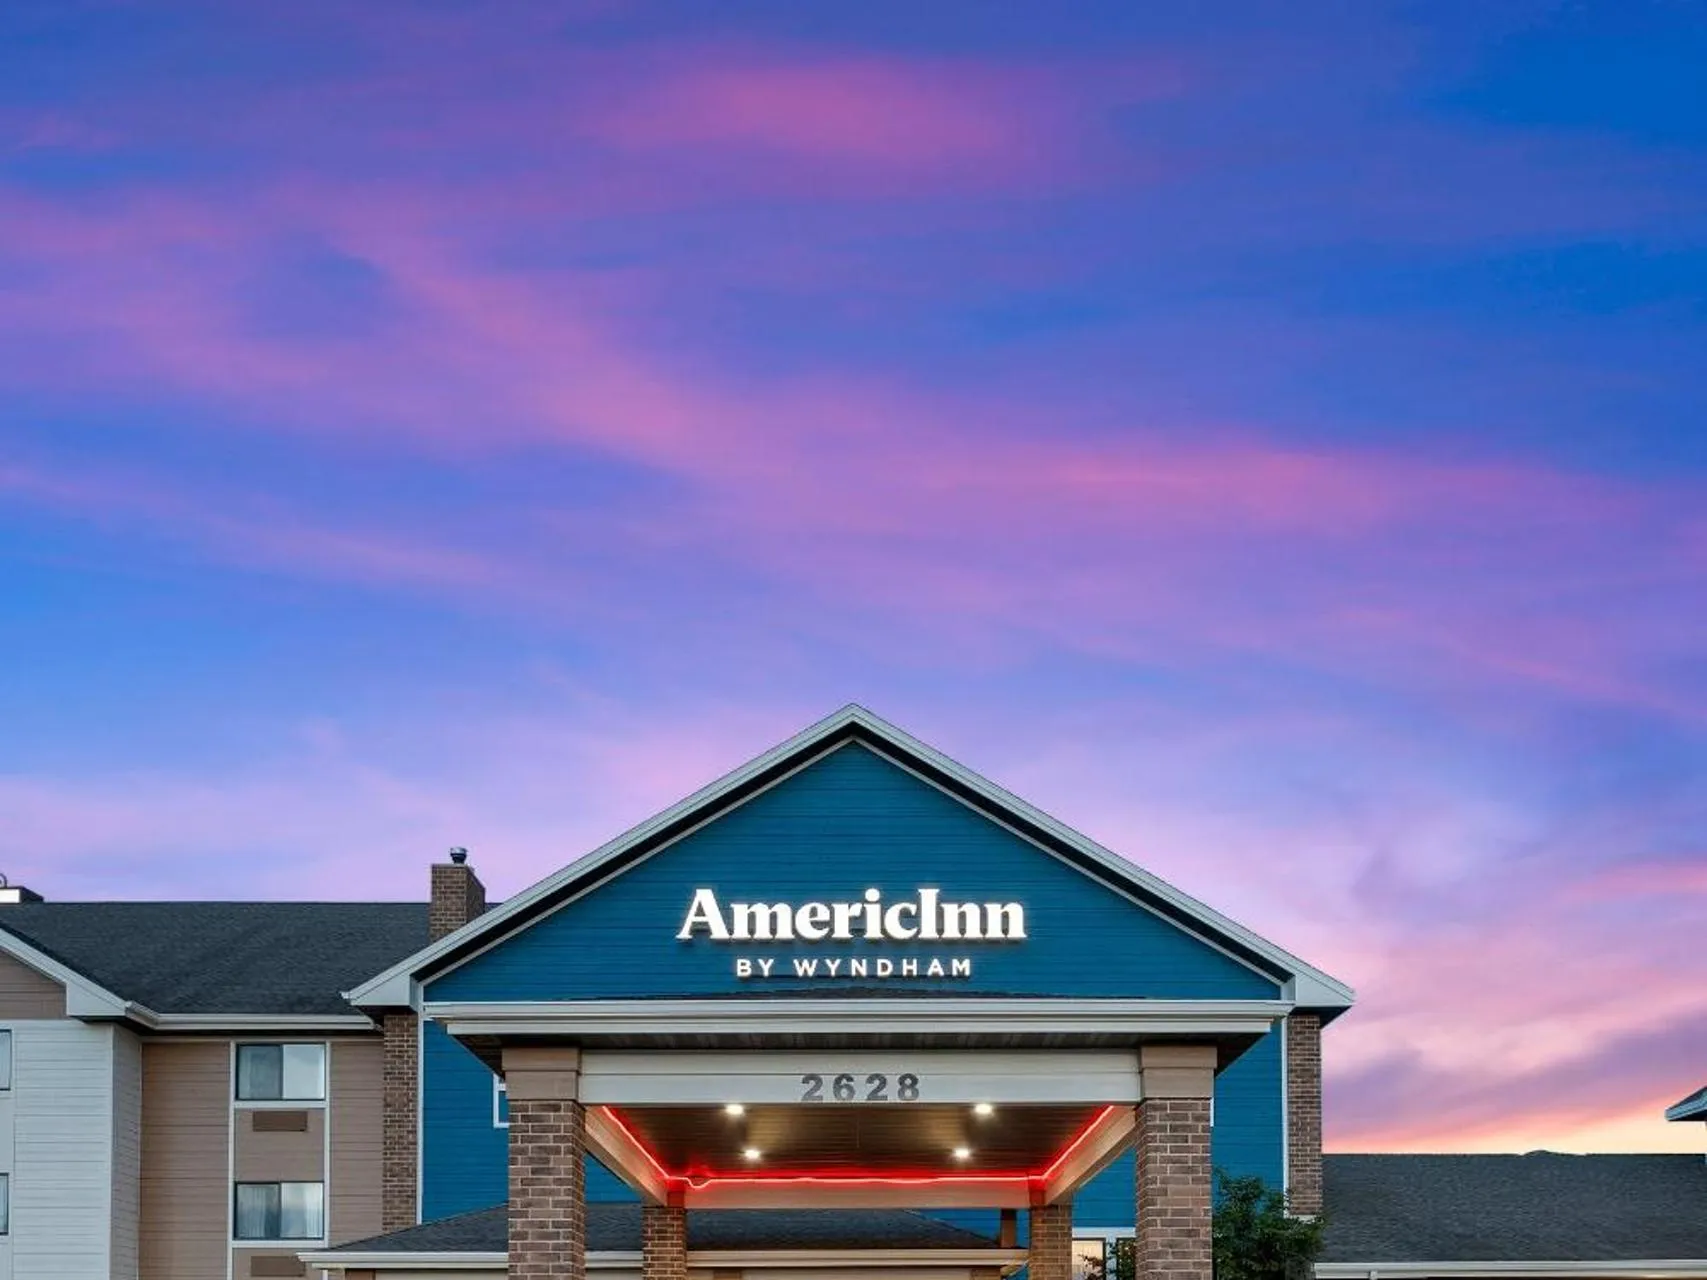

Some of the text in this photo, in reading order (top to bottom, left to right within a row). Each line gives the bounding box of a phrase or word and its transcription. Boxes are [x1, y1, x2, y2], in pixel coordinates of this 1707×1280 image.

[675, 888, 1027, 940] AmericInn
[736, 958, 972, 977] BY WYNDHAM
[801, 1073, 920, 1101] 2628
